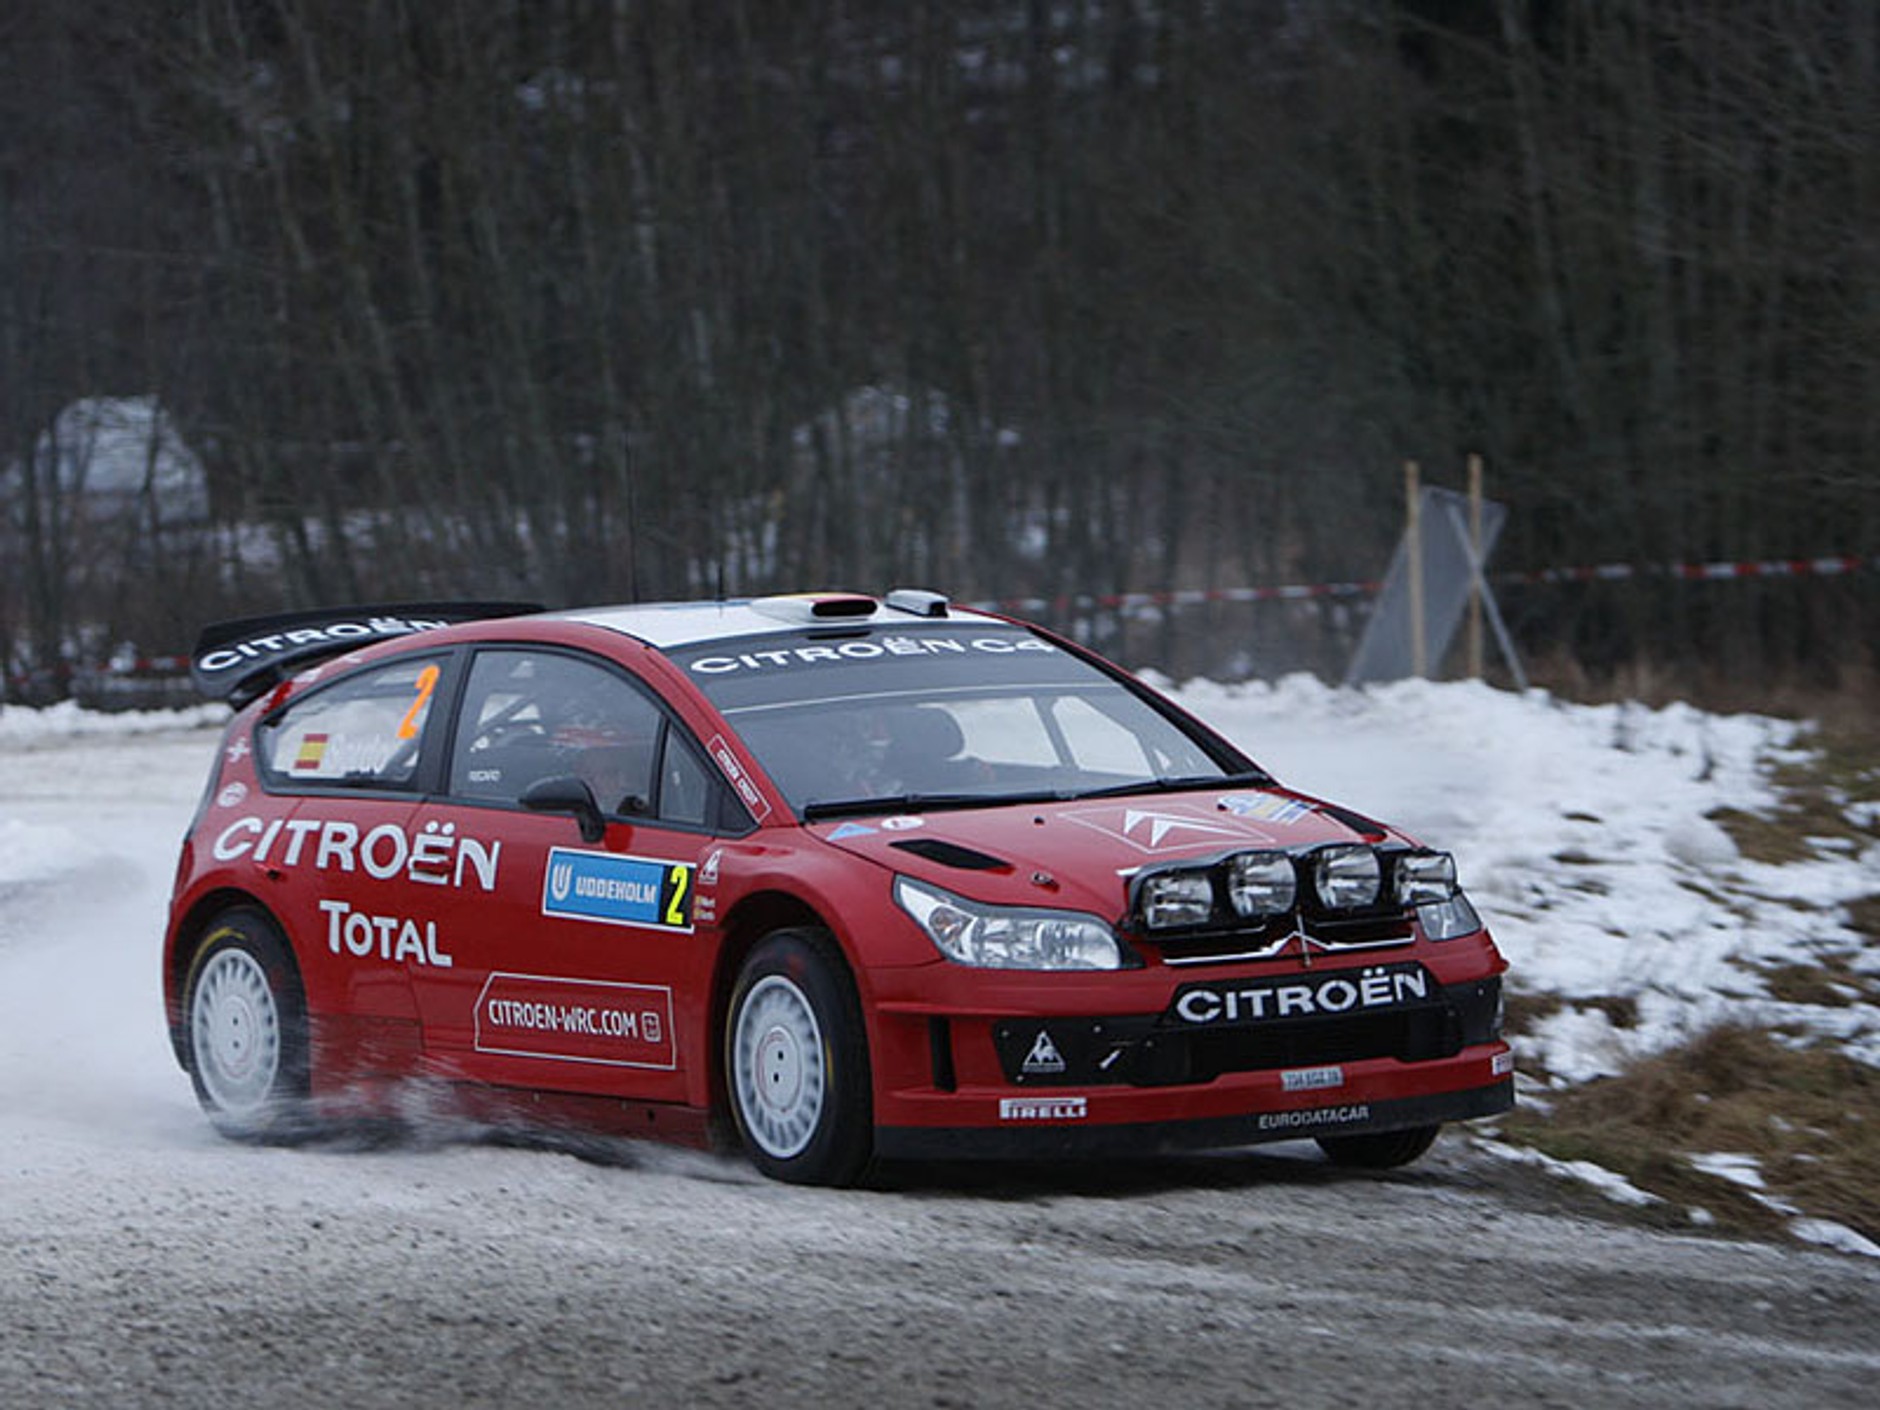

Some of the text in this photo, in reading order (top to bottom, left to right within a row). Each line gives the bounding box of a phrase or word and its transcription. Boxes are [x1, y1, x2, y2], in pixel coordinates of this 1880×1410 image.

[199, 616, 450, 671] CITROËN
[690, 637, 966, 675] CITROËN
[397, 665, 440, 740] 2
[213, 816, 501, 891] CITROËN
[575, 875, 657, 905] UDDEHOLM
[665, 866, 689, 926] 2
[488, 998, 638, 1038] CITROEN-WRC.COM
[1175, 966, 1428, 1024] CITROËN
[999, 1097, 1087, 1120] PIRELLI
[1258, 1105, 1370, 1131] EURODATACAR
